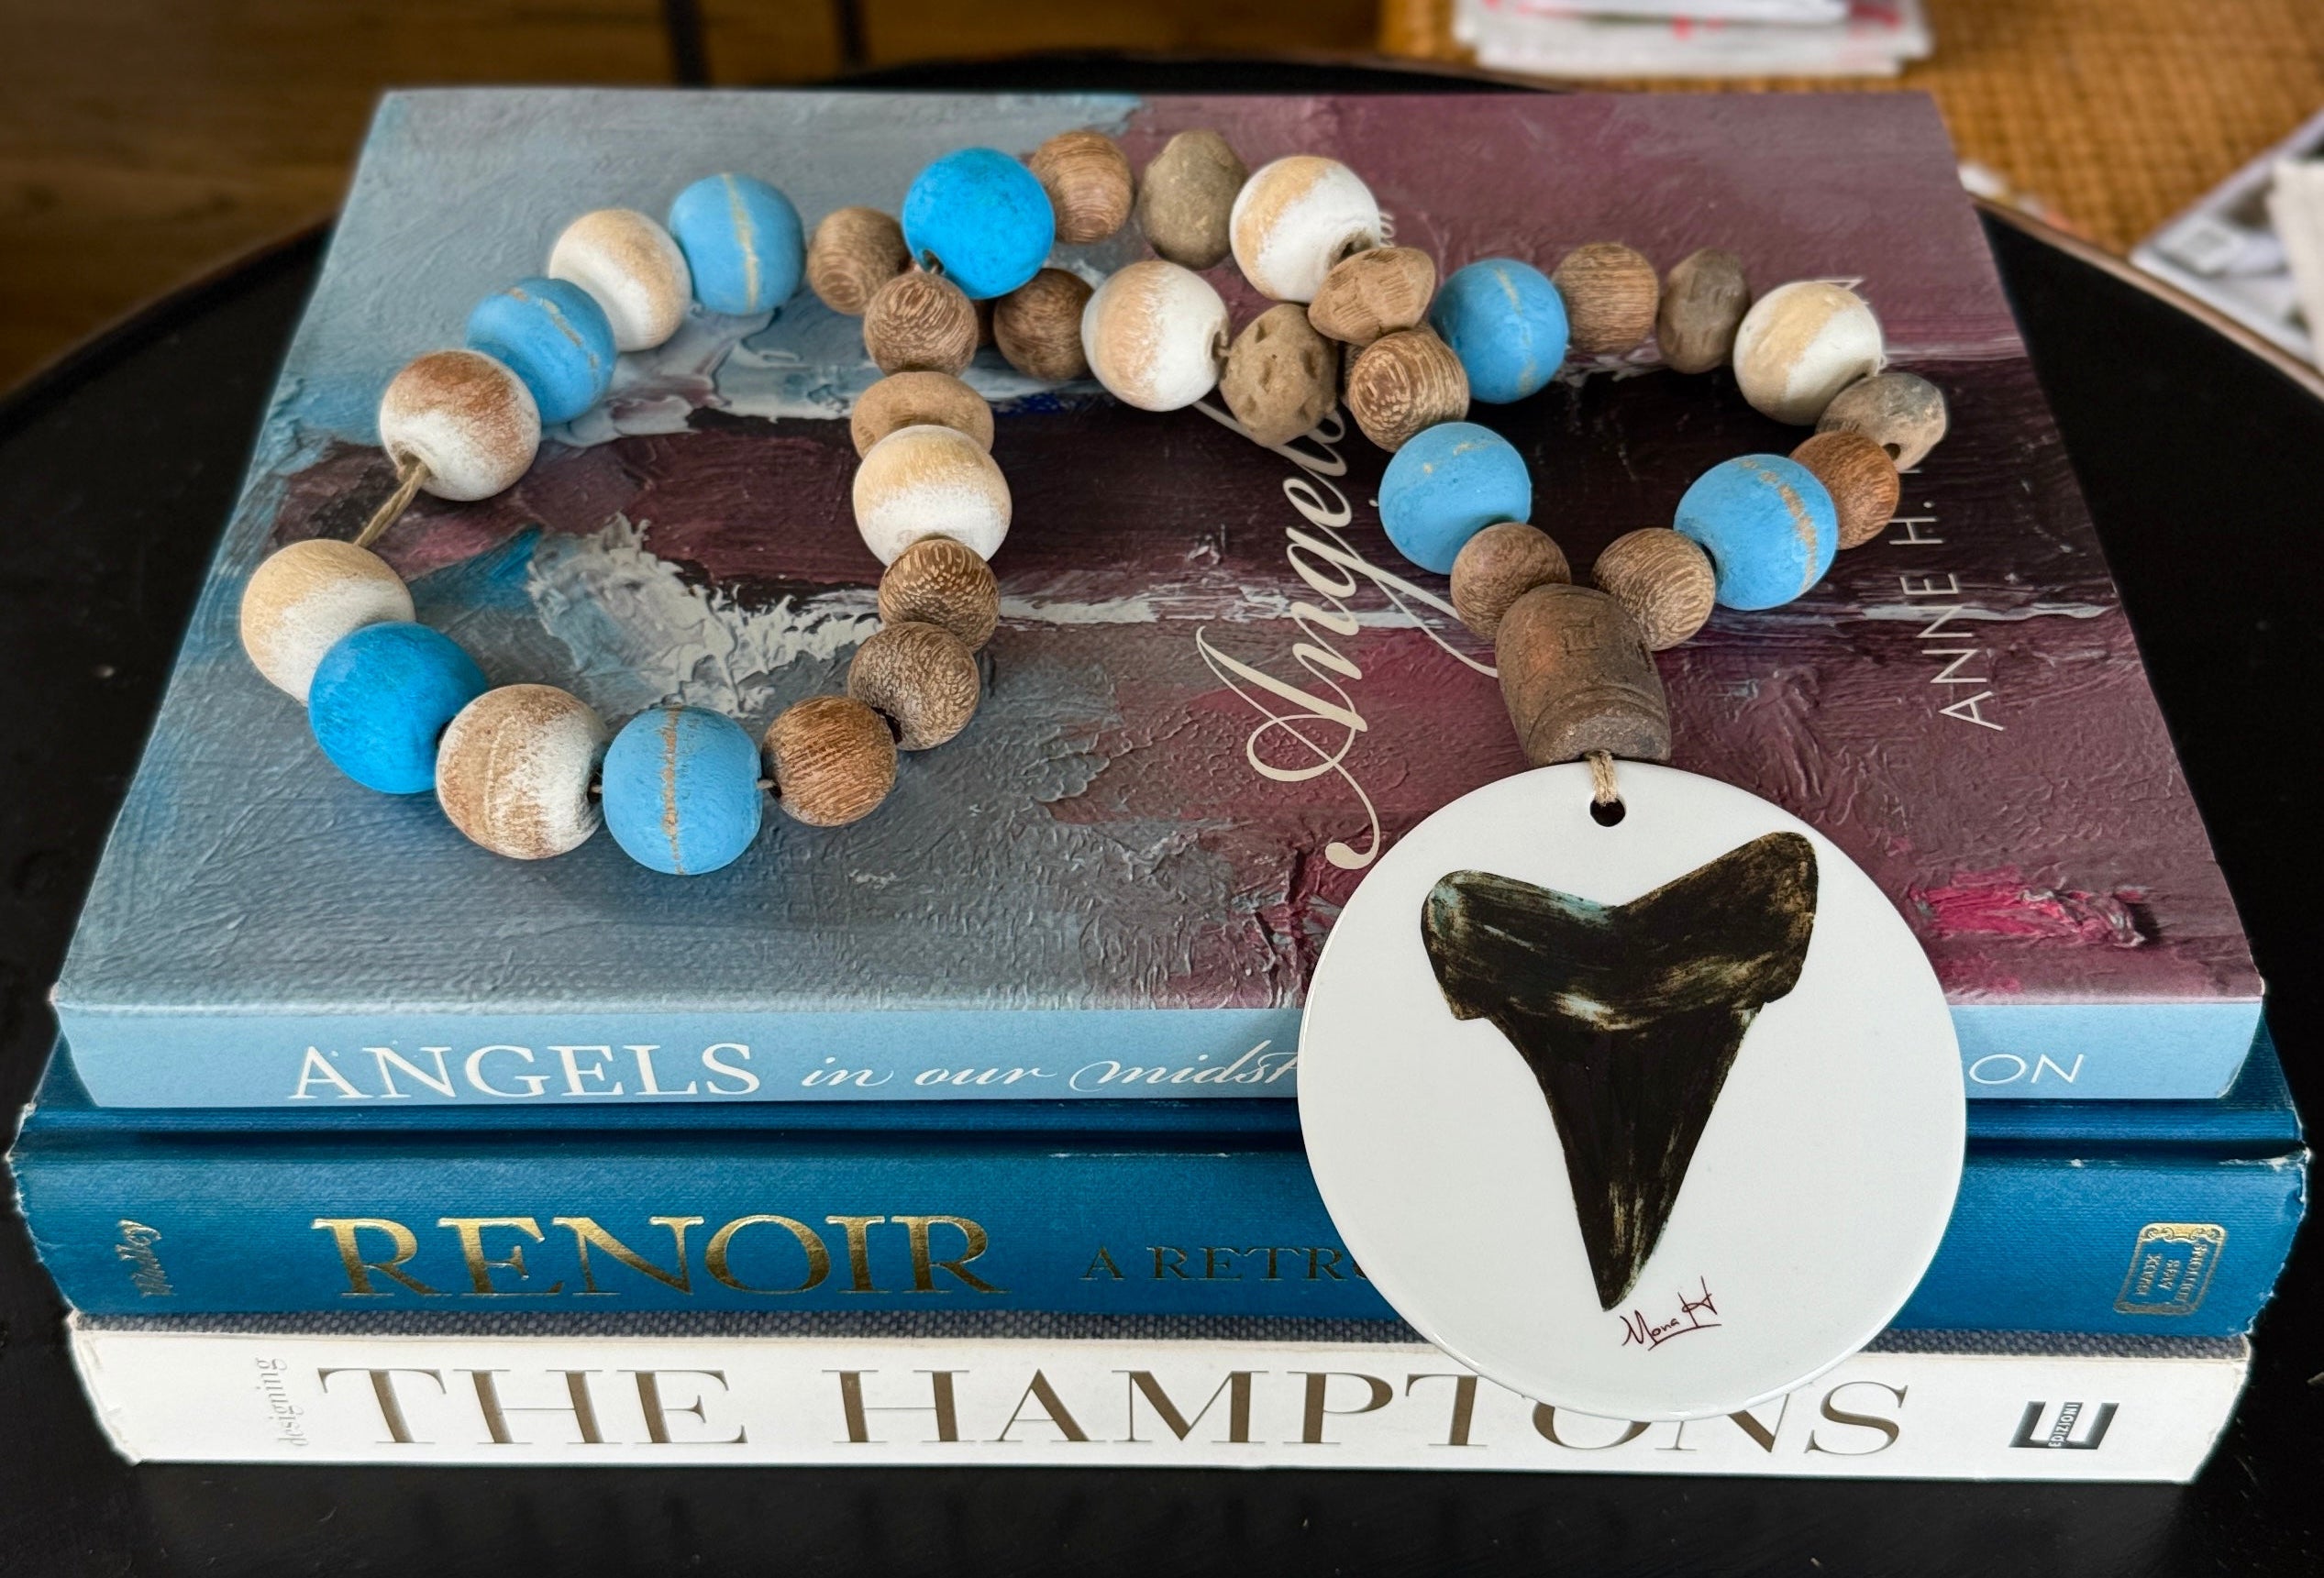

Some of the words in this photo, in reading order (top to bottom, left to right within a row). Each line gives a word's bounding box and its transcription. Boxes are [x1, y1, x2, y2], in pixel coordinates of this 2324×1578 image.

[1888, 501, 1945, 546] H.
[1898, 572, 2006, 733] ANNE
[290, 1043, 761, 1099] ANGELS
[801, 1056, 893, 1087] in
[913, 1060, 1057, 1086] our
[309, 1213, 1013, 1298] RENOIR
[1079, 1247, 1126, 1281] A
[254, 1357, 310, 1447] designing
[316, 1366, 748, 1446] THE
[821, 1369, 1909, 1457] HAMPTONS
[2047, 1402, 2081, 1448] EDIZIONI
